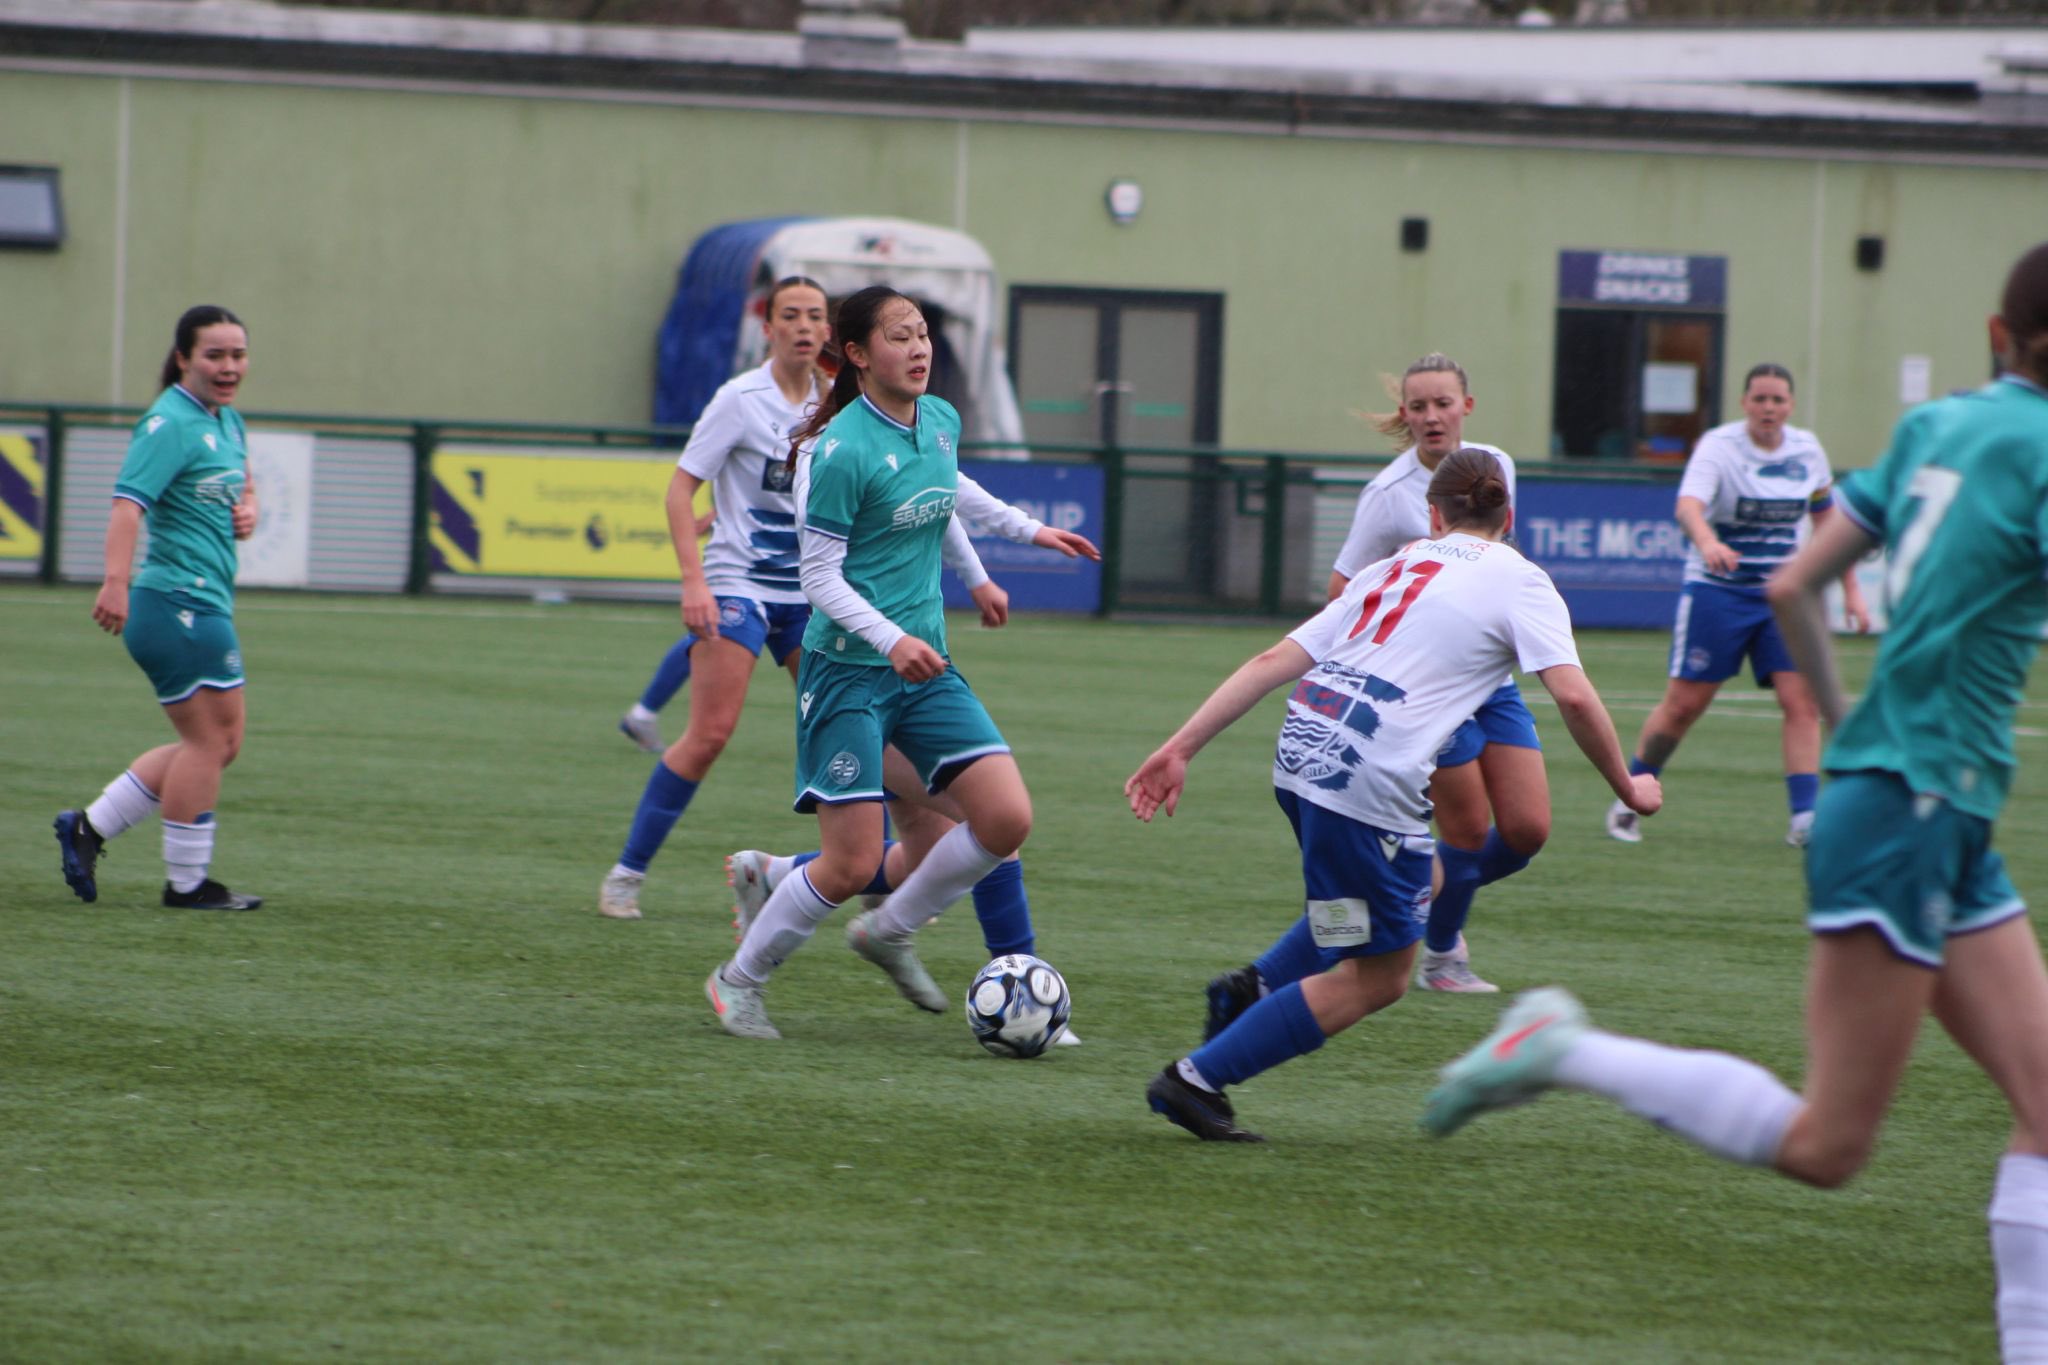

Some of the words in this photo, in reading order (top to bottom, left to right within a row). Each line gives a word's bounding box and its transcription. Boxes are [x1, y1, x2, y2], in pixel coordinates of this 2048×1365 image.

[1599, 254, 1688, 277] DRINKS
[1596, 279, 1689, 303] SNACKS
[894, 501, 940, 525] SELECT
[1529, 517, 1594, 557] THE
[1890, 465, 1962, 604] 7
[1349, 559, 1445, 644] 11
